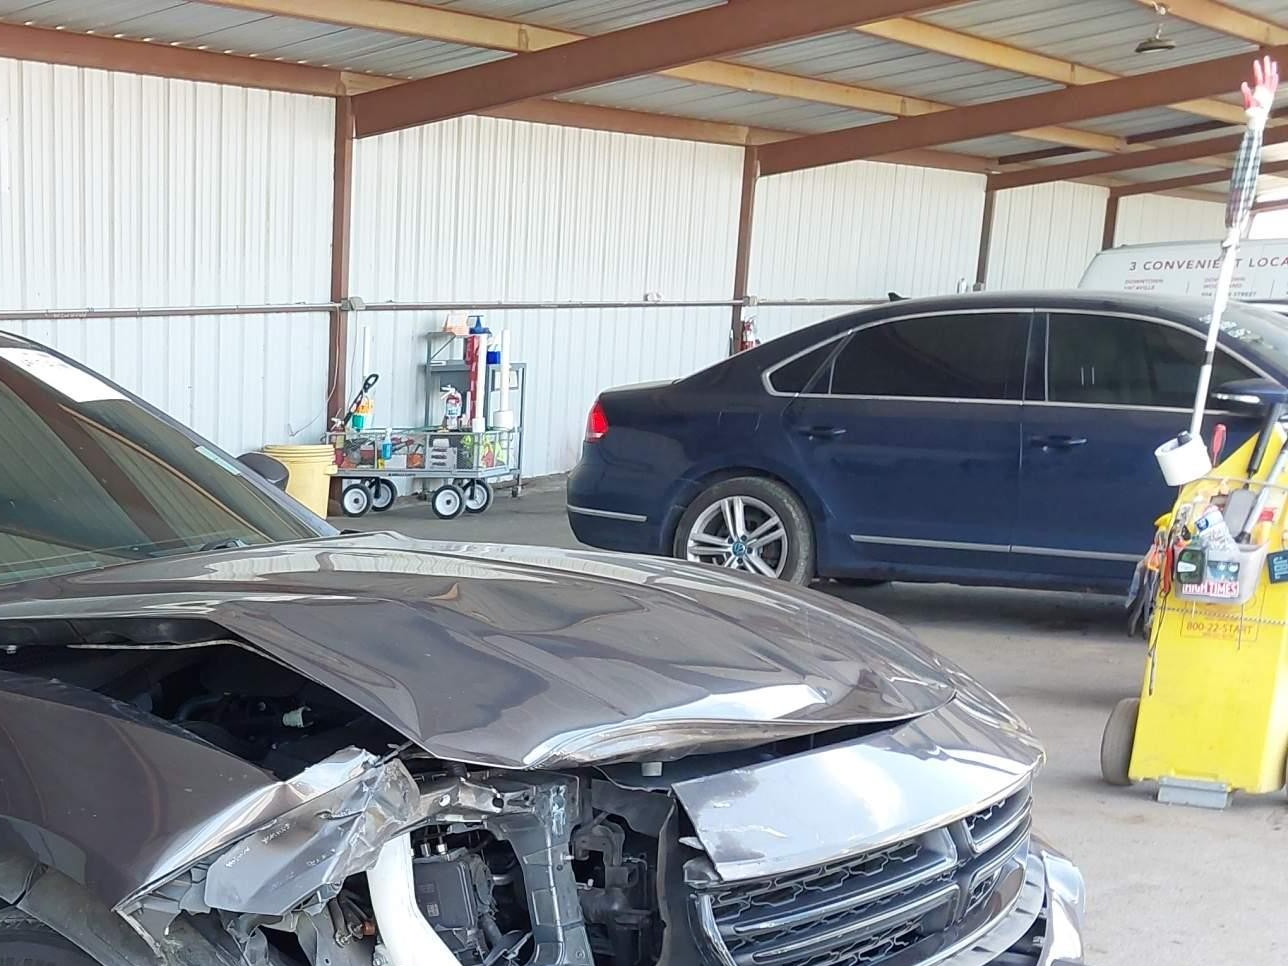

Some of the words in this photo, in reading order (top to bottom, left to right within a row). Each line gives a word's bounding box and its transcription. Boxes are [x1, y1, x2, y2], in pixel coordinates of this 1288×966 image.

[1129, 261, 1137, 271] 3
[1143, 257, 1243, 271] CONVENIET
[1209, 581, 1240, 596] TIMES
